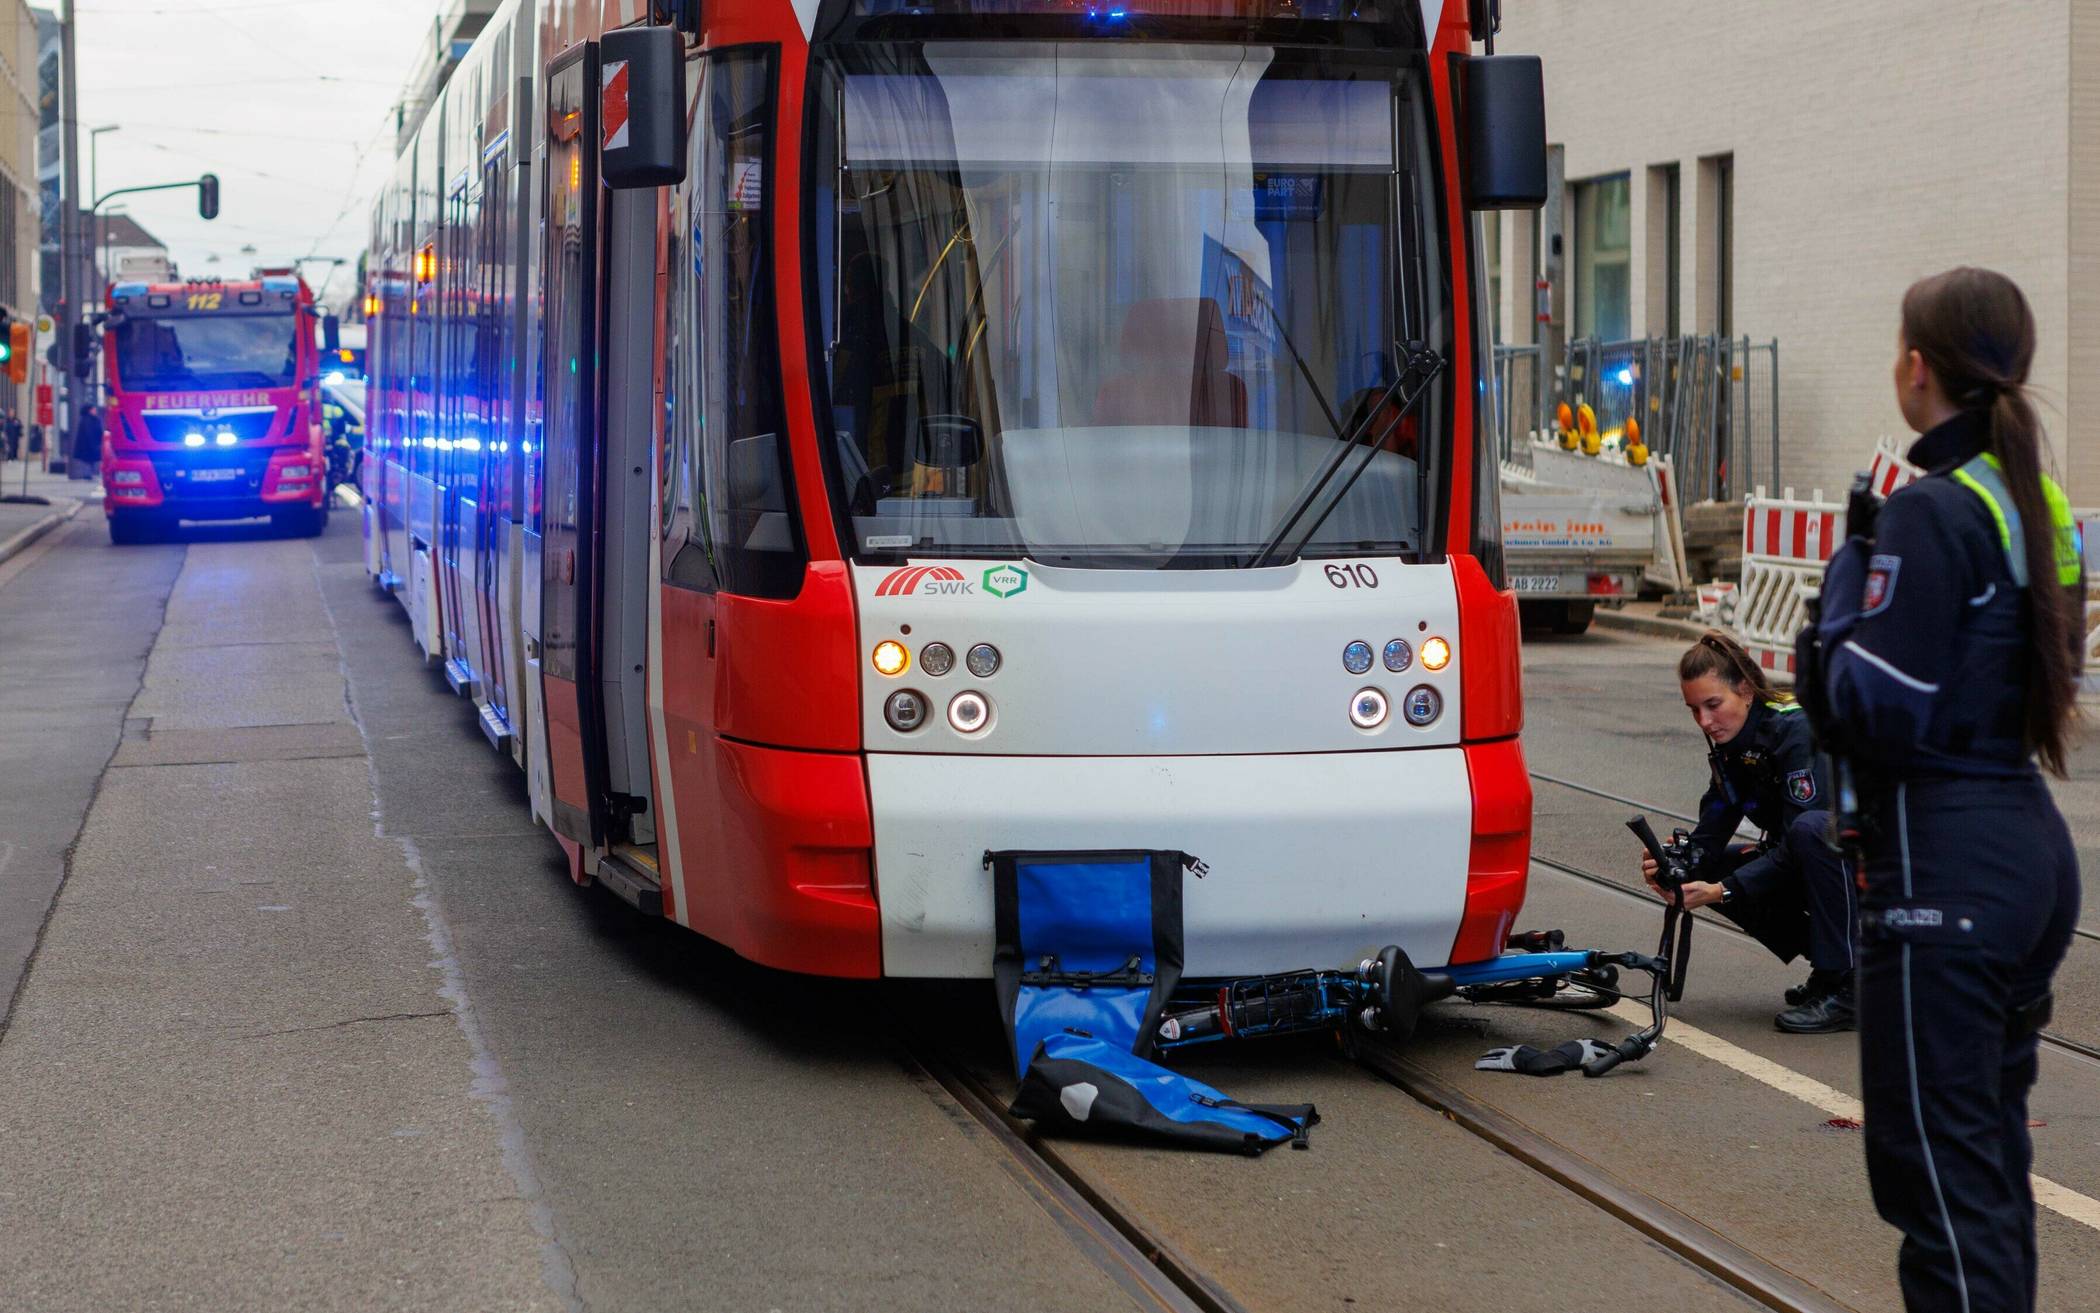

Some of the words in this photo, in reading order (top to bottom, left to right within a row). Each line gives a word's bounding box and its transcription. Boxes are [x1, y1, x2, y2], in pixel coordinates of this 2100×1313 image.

[1267, 178, 1296, 188] EURO
[1267, 187, 1295, 197] PART
[188, 293, 222, 310] 112
[145, 392, 270, 409] FEUERWEHR
[993, 576, 1018, 584] VRR
[1323, 563, 1379, 589] 610
[1514, 576, 1529, 590] AB
[1531, 576, 1559, 590] 2222
[924, 582, 975, 595] SWK
[1884, 908, 1943, 927] POLIZEI
